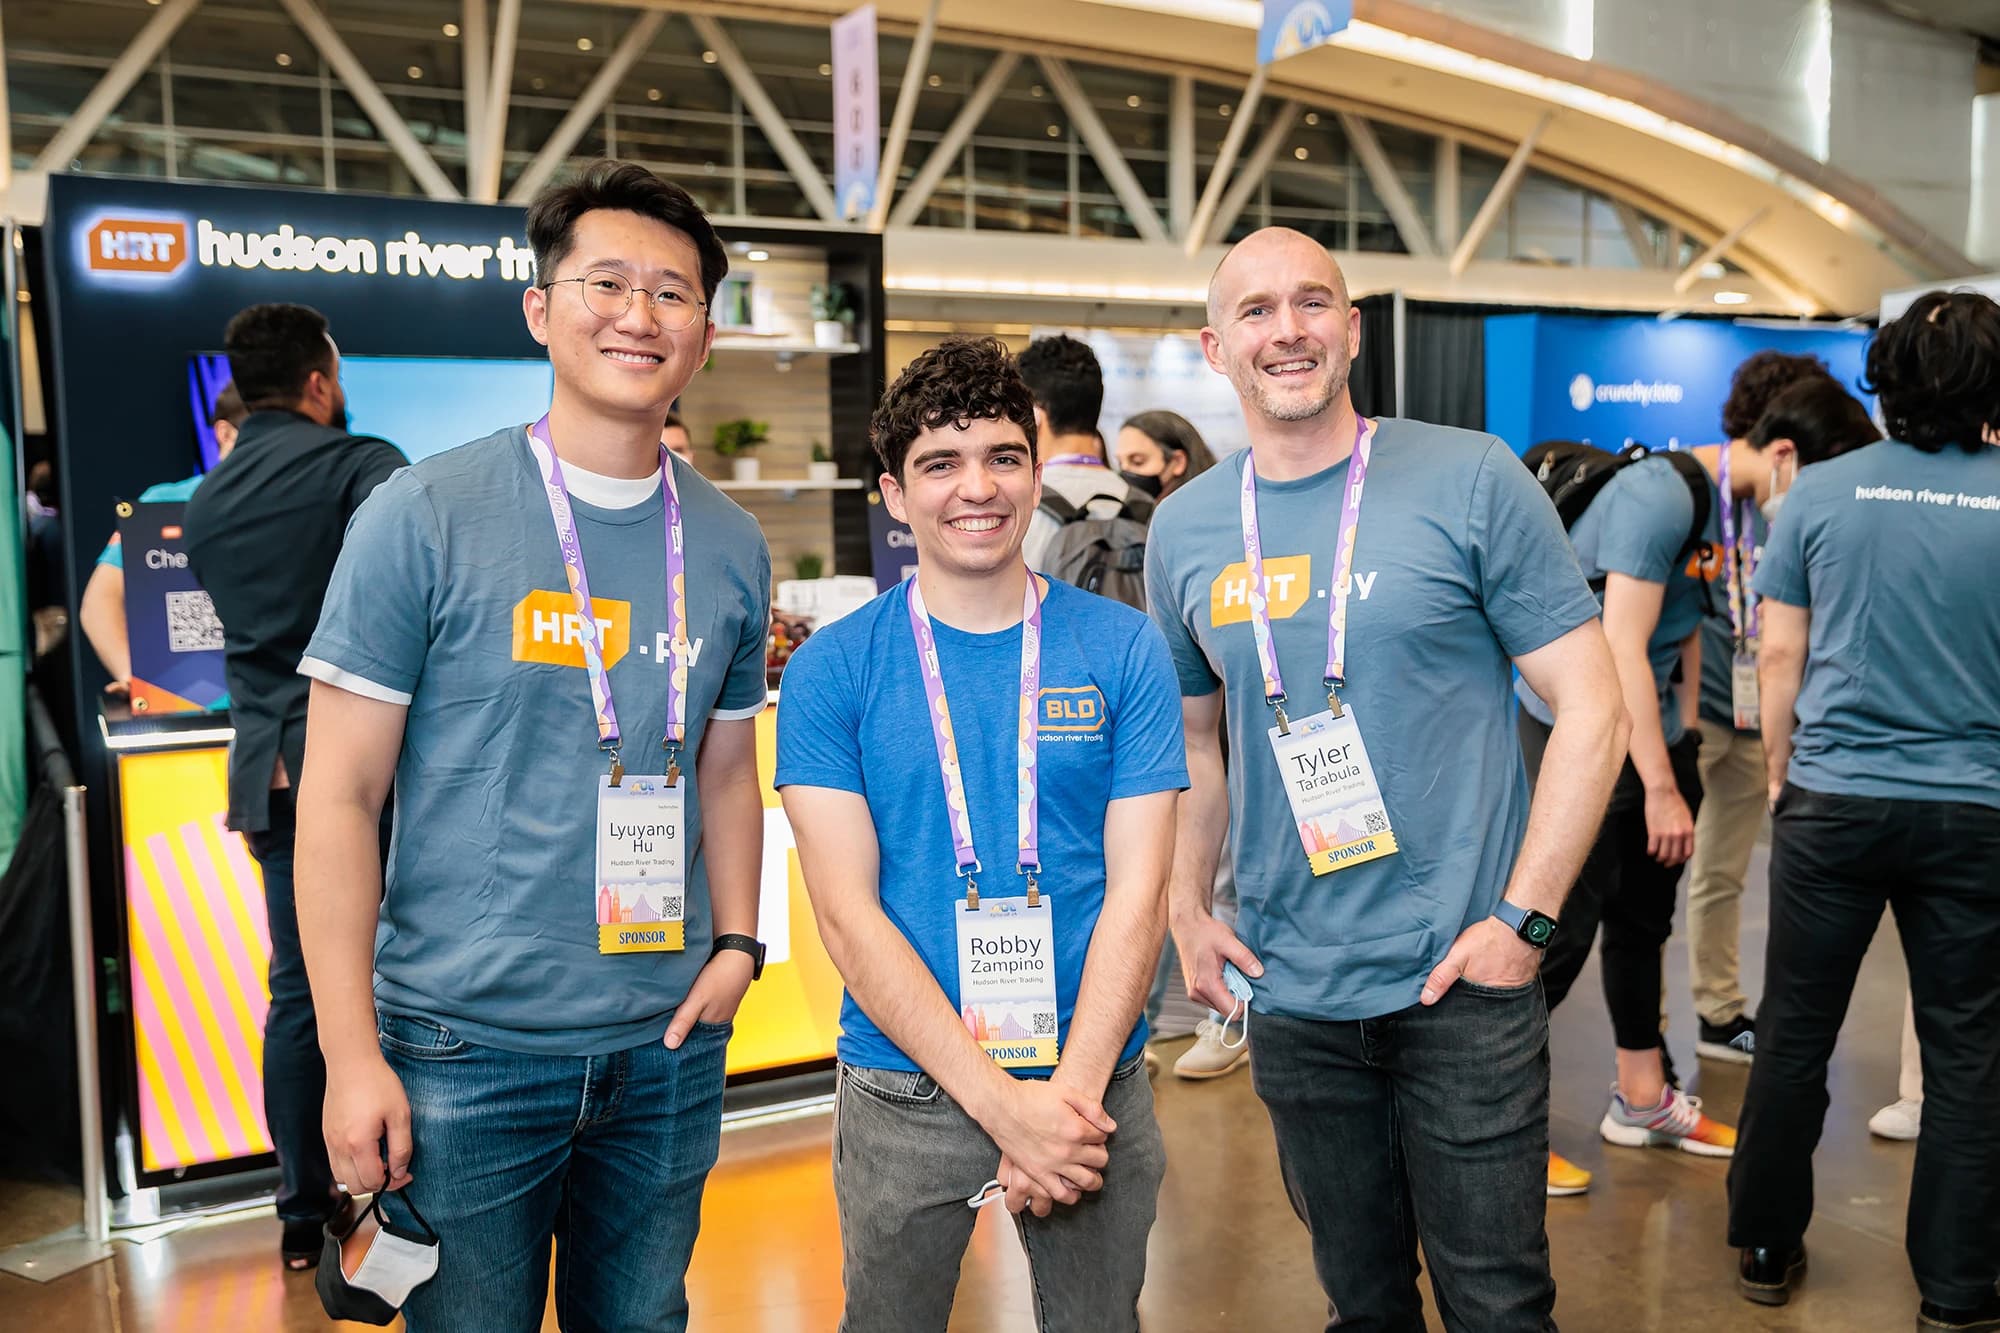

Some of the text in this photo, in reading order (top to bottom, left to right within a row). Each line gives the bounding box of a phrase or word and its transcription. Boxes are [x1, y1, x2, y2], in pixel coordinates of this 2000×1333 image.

[100, 230, 176, 262] HRT
[197, 219, 536, 281] hudson river tr
[1855, 485, 1913, 501] hudson
[1916, 489, 1954, 505] river
[145, 549, 189, 569] Che
[533, 610, 613, 650] HRT
[1046, 699, 1096, 719] BLD
[1065, 733, 1083, 742] river
[1291, 743, 1351, 777] Tyler
[1296, 764, 1361, 792] Tarabula
[610, 822, 676, 841] Lyuyang
[633, 840, 653, 853] Hu
[1327, 839, 1377, 864] SPONSOR
[610, 858, 675, 868] Hudson River Trading
[619, 930, 667, 945] SPONSOR
[970, 935, 1042, 957] Robby
[971, 957, 1044, 975] Zampino
[999, 977, 1018, 985] River
[985, 1046, 1038, 1060] SPONSOR
